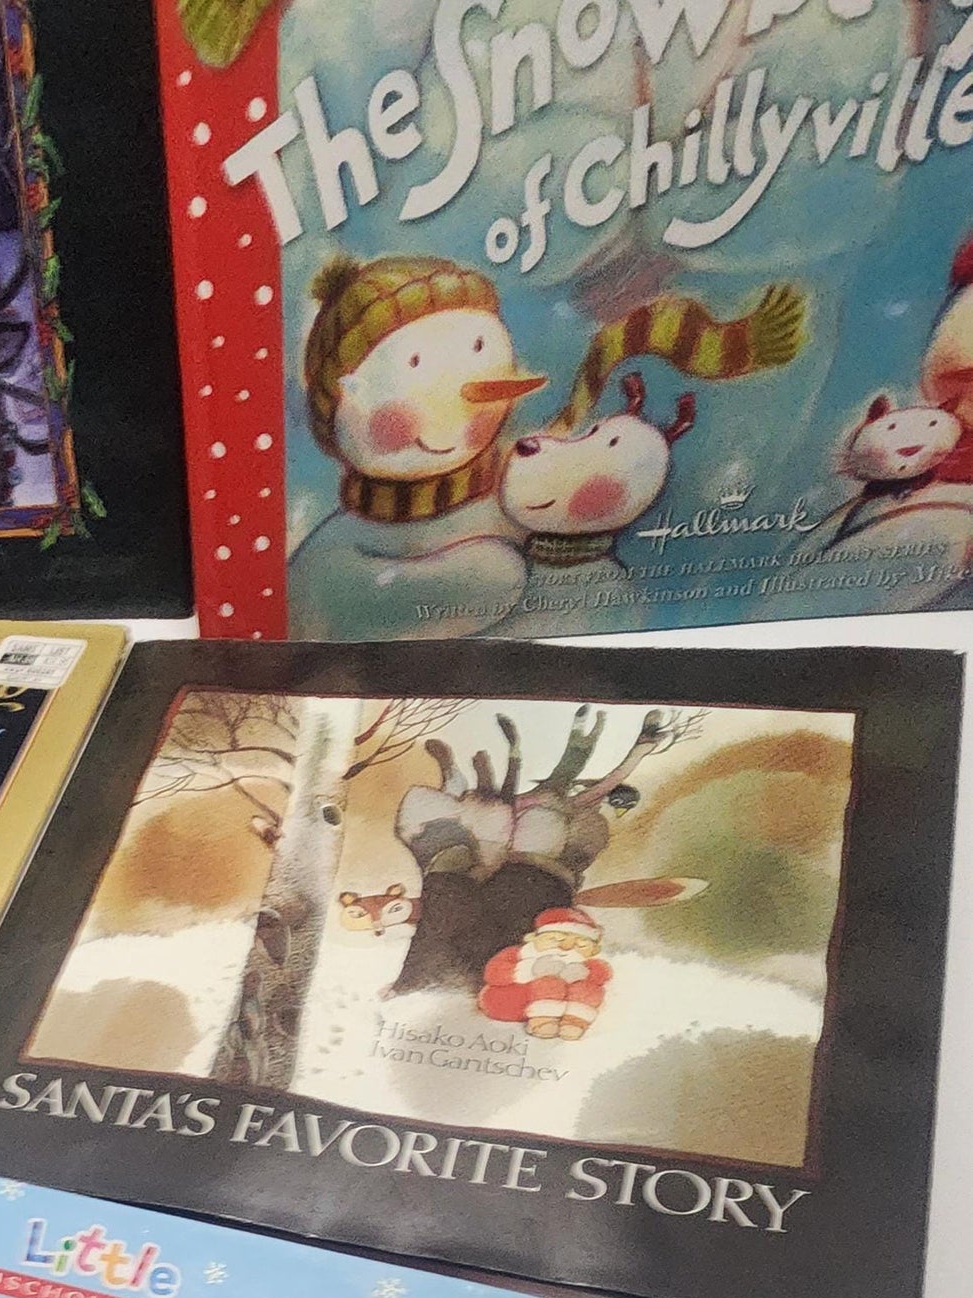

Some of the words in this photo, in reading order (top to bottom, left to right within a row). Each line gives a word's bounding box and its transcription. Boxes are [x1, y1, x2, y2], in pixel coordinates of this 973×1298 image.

[221, 64, 423, 246] The
[483, 153, 553, 274] of
[562, 45, 973, 250] Chillyville
[635, 497, 823, 556] Hallmark
[521, 594, 588, 615] Cheryl
[592, 584, 709, 609] Hawkinson
[714, 578, 755, 599] and
[759, 571, 871, 597] Illustrated
[876, 568, 907, 591] by
[637, 562, 676, 581] THE
[679, 553, 782, 577] HALLMARK
[787, 547, 875, 568] HOLIDAY
[370, 1040, 425, 1065] Ivan
[428, 1049, 571, 1082] Gantschev
[376, 1019, 465, 1049] Hisako
[467, 1033, 529, 1056] Aoki
[229, 1102, 548, 1194] FAVORITE
[565, 1156, 811, 1234] STORY
[23, 1218, 182, 1298] Little
